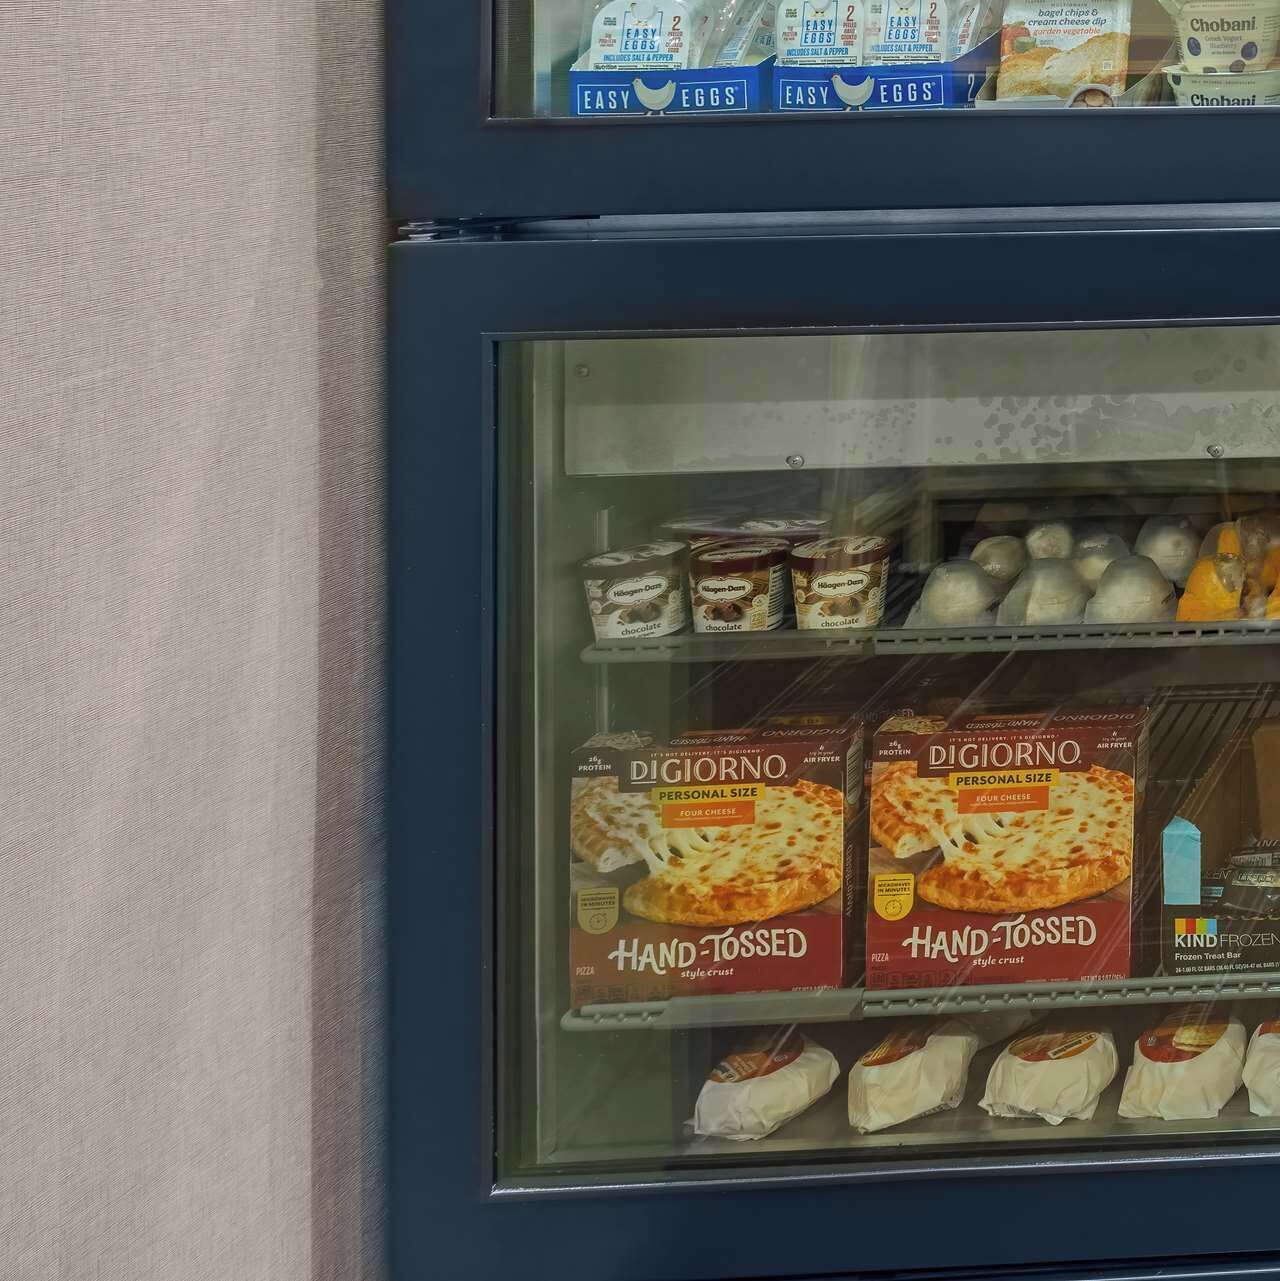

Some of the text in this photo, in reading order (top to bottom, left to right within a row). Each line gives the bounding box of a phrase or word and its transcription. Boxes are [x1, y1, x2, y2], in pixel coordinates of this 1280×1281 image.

[805, 20, 833, 31] EASY
[890, 16, 916, 27] EASY
[1028, 18, 1056, 26] cream
[1092, 17, 1106, 26] dip
[626, 28, 656, 39] EASY
[584, 86, 736, 109] EASY EGGS
[786, 83, 932, 105] EASY EGGS
[621, 622, 662, 636] chocolate
[578, 764, 612, 772] PROTEIN
[956, 773, 1052, 786] PERSONAL SIZE
[659, 787, 758, 801] PERSONAL SIZE
[704, 808, 736, 816] CHEESE
[1175, 934, 1218, 948] KIND
[1175, 953, 1202, 961] Frozen
[681, 968, 734, 978] style crust
